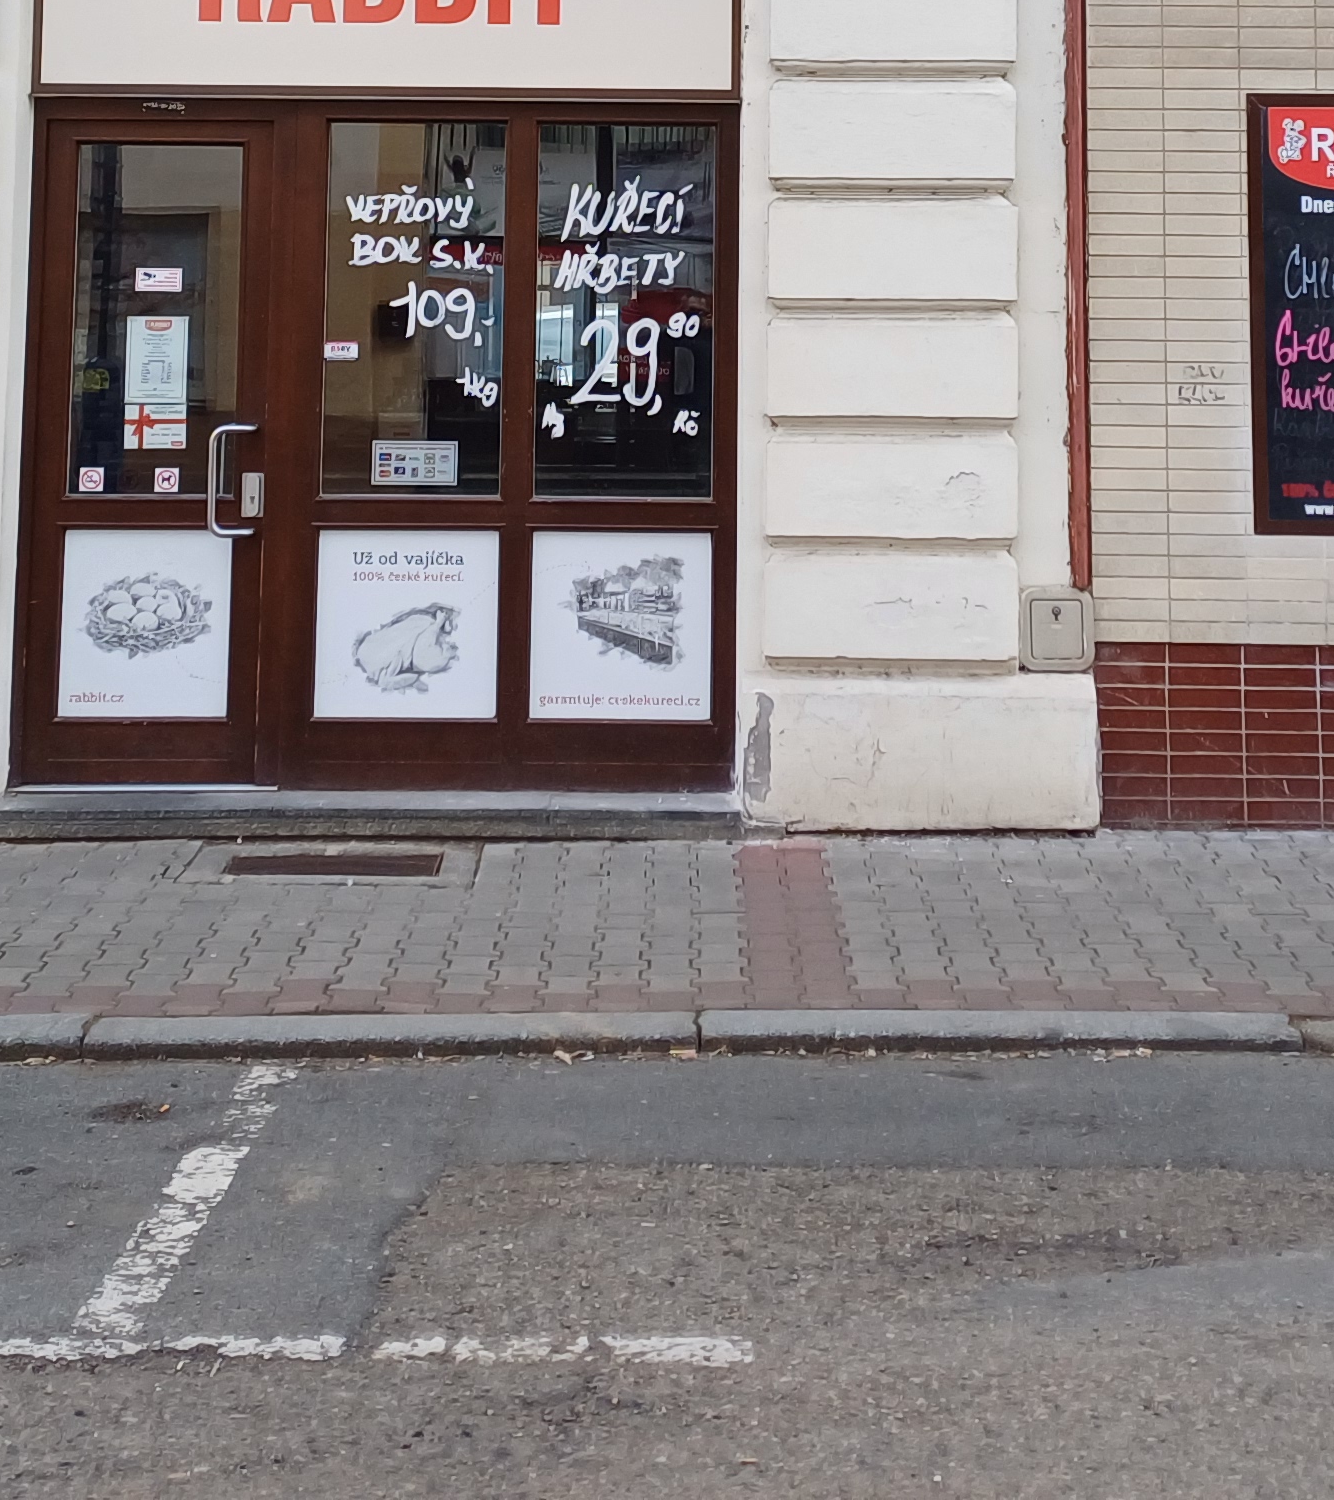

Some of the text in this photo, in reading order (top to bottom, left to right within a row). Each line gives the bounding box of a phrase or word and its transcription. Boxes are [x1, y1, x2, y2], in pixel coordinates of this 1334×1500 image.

[560, 175, 694, 243] KUŘECÍ
[348, 233, 422, 266] BOK
[554, 241, 685, 294] HŘBETY
[352, 550, 464, 570] Už od vajíčka
[353, 571, 384, 582] 100%
[388, 571, 420, 582] české
[69, 692, 124, 703] rabbit.cz
